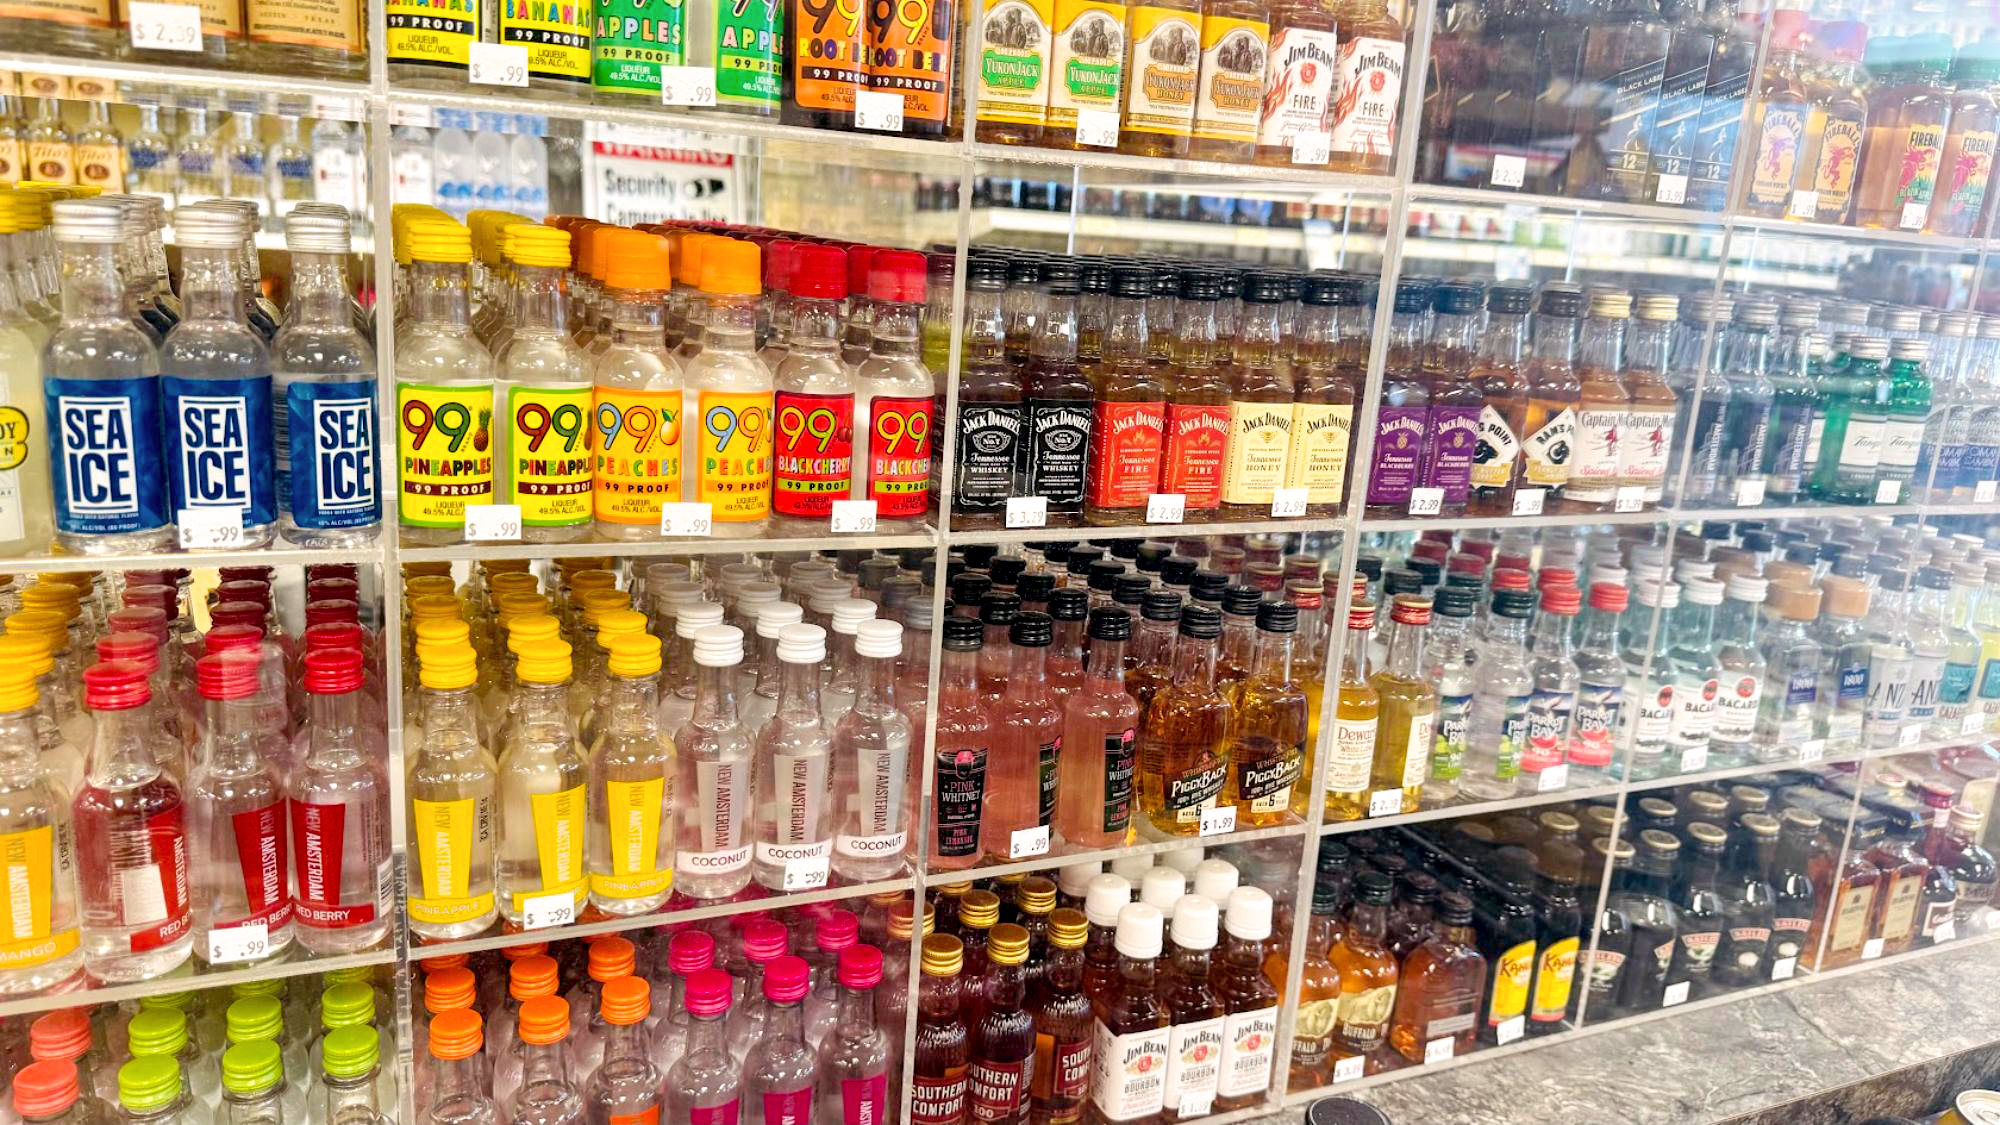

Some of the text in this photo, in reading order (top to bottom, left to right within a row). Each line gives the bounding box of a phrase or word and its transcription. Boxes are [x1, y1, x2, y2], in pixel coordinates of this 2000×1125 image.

[390, 16, 464, 34] 99 PROOF
[597, 16, 682, 46] APPLES
[407, 34, 439, 46] LIQUEUR
[515, 29, 585, 47] 99 PROOF
[537, 48, 568, 60] LIQUEUR
[602, 47, 671, 63] 99 PROOF
[1284, 42, 1333, 71] JIM BEAM
[473, 64, 481, 79] $
[813, 68, 831, 79] 99
[1355, 52, 1401, 79] JIM BEAM
[876, 77, 937, 91] 99 PROOF
[1156, 89, 1184, 101] HONEY
[1293, 95, 1316, 110] FIRE
[1362, 102, 1385, 117] FIRE
[1623, 154, 1636, 169] 12
[1667, 159, 1680, 174] 12
[1708, 165, 1720, 179] 12
[605, 169, 675, 203] Security
[66, 407, 128, 450] SEA
[184, 406, 243, 449] SEA
[402, 399, 471, 453] 99
[517, 402, 583, 454] 99
[597, 401, 658, 454] 99
[705, 405, 765, 453] 99
[962, 416, 987, 435] JACK
[1035, 416, 1059, 433] JACK
[1112, 416, 1135, 435] JACK
[1581, 413, 1616, 428] Captain
[1625, 413, 1660, 428] Captain
[319, 409, 370, 450] SEA
[779, 405, 836, 454] 99
[875, 411, 929, 455] 99
[1488, 423, 1513, 446] POINT
[1536, 424, 1565, 445] RAM'S
[970, 453, 1011, 463] Tennessee
[1042, 451, 1081, 461] Tennessee
[1119, 455, 1155, 465] Tennessee
[1184, 455, 1219, 465] Tennessee
[405, 456, 491, 477] PINEAPPLES
[597, 455, 678, 477] PEACHES
[1124, 465, 1149, 473] FIRE
[1188, 466, 1213, 475] FIRE
[69, 452, 132, 503] ICE
[188, 450, 246, 501] ICE
[321, 450, 371, 501] ICE
[414, 483, 485, 496] 99 PROOF
[530, 481, 592, 495] 99 PROOF
[605, 482, 670, 494] 99 PROOF
[717, 483, 733, 492] 99
[787, 481, 845, 491] 99 PROOF
[436, 500, 465, 509] LIQUEUR
[552, 499, 577, 508] LIQUEUR
[1531, 725, 1557, 738] BAY
[1582, 717, 1607, 732] BAY
[874, 753, 890, 832] NEW AMSTERDAM
[950, 780, 976, 792] PINK
[790, 760, 808, 841] NEW AMSTERDAM
[941, 791, 981, 803] WHITNEY
[715, 764, 733, 848] NEW AMSTERDAM
[628, 786, 644, 872] NEW AMSTERDAM
[557, 794, 571, 883] NEW AMSTERDAM
[851, 835, 903, 851] COCONUT
[260, 810, 280, 905] NEW AMSTERDAM
[306, 807, 324, 901] NEW AMSTERDAM
[435, 806, 452, 897] NEW AMSTERDAM
[692, 850, 747, 867] COCONUT
[768, 845, 824, 859] COCONUT
[174, 836, 188, 908] AMSTERDAM
[8, 837, 33, 939] NEW AMSTERDAM
[313, 909, 350, 921] BERRY
[160, 921, 181, 939] RED
[213, 945, 222, 959] $
[1234, 1020, 1275, 1042] JIM BEAM
[1343, 1024, 1377, 1039] BUFFALO
[1180, 1030, 1221, 1053] JIM BEAM
[1123, 1041, 1167, 1064] JIM BEAM
[1234, 1056, 1268, 1070] BOURBON
[1180, 1067, 1216, 1082] BOURBON
[1124, 1078, 1161, 1093] BOURBON
[913, 1096, 963, 1115] COMFORT
[973, 1105, 994, 1118] 100
